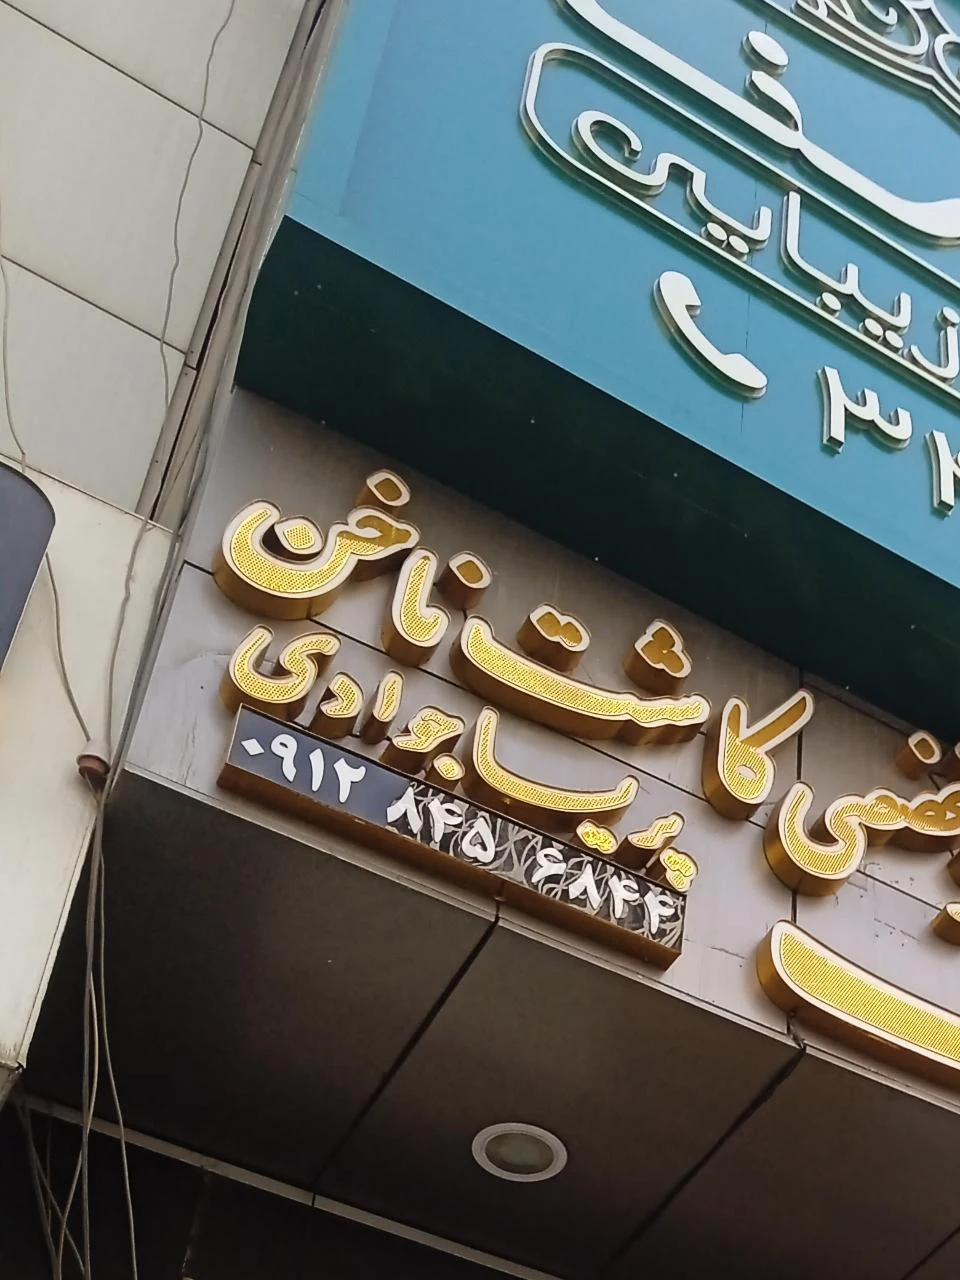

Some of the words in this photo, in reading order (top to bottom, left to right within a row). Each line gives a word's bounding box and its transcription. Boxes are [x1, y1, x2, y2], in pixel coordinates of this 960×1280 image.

[216, 468, 492, 660] ناخن
[450, 602, 815, 818] کاشت
[240, 733, 367, 804] ۰۹۱۲
[386, 786, 498, 864] ۸۴۵
[531, 847, 679, 935] ۶۸۴۴
